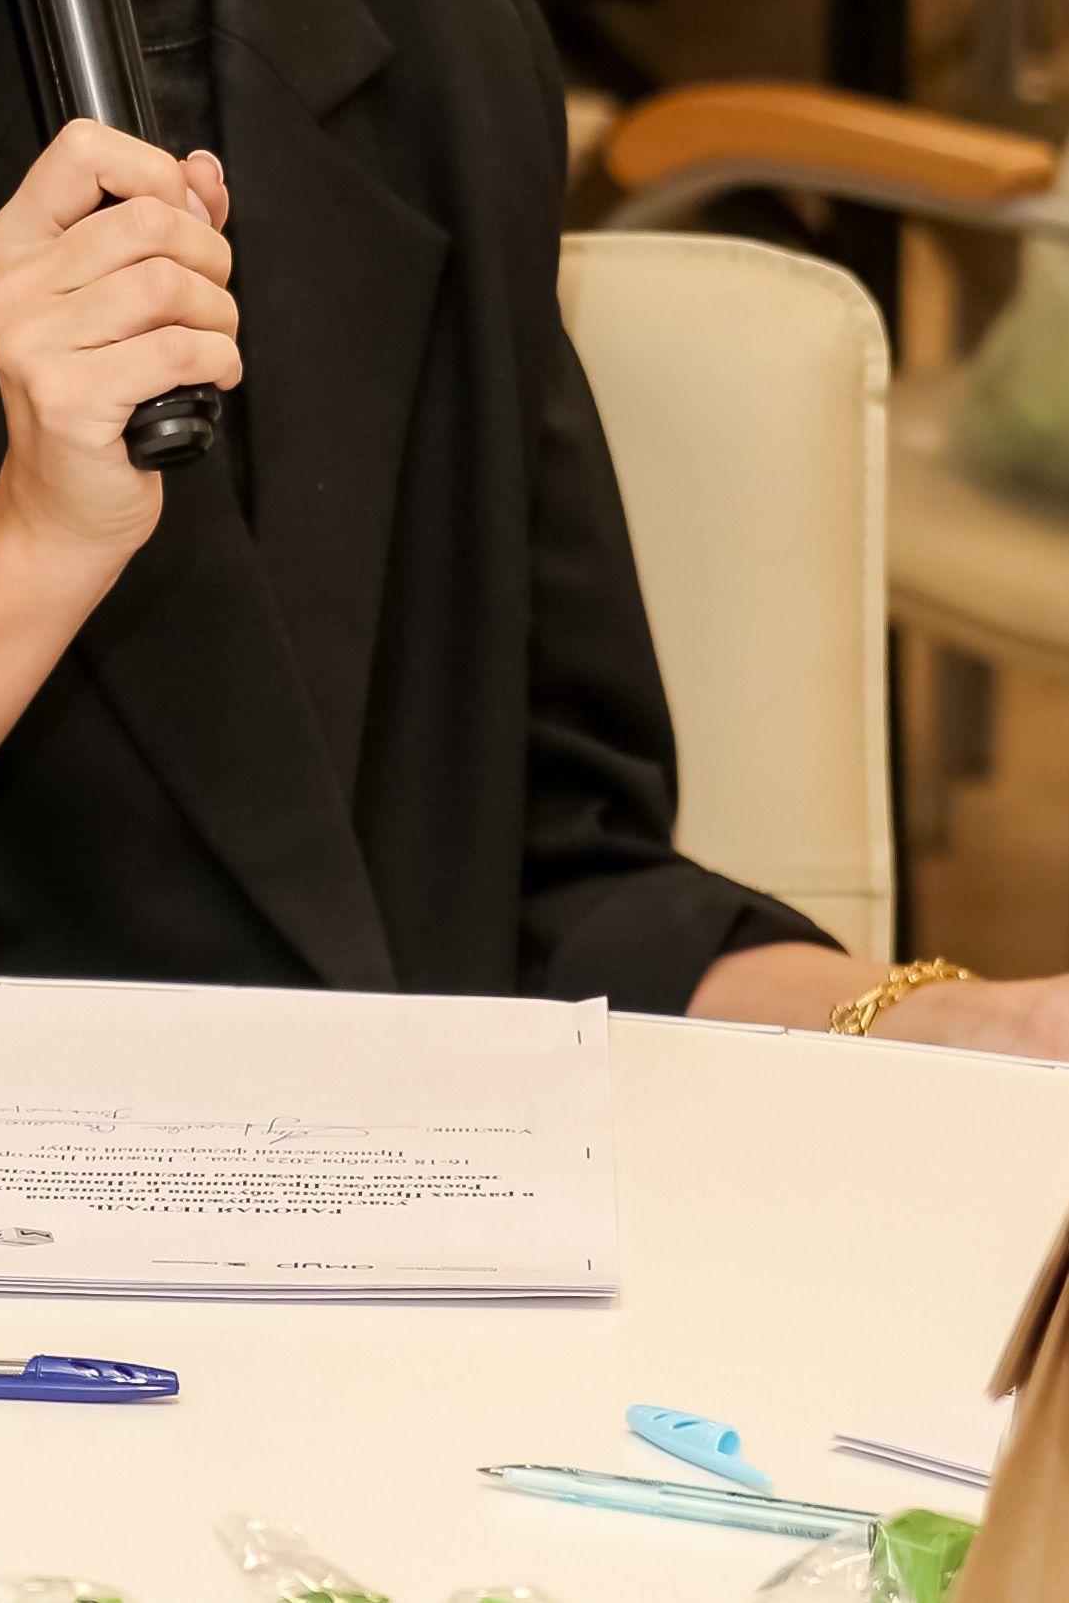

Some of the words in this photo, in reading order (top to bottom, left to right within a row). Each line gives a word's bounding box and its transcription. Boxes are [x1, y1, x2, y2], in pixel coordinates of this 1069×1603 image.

[40, 1144, 97, 1153] округ
[104, 1146, 247, 1156] федеральный
[255, 1149, 404, 1158] Приволжский
[85, 1155, 173, 1163] Нижний
[266, 1157, 314, 1165] 2025
[322, 1157, 407, 1166] октября
[213, 1172, 365, 1181] молодежного
[168, 1188, 275, 1197] обучения
[282, 1190, 422, 1199] Программы
[431, 1190, 515, 1198] рамках
[25, 1194, 147, 1202] интенсива
[287, 1198, 409, 1206] участника
[88, 1203, 209, 1214] ТЕТРАДЬ
[217, 1206, 342, 1215] РАБОЧАЯ
